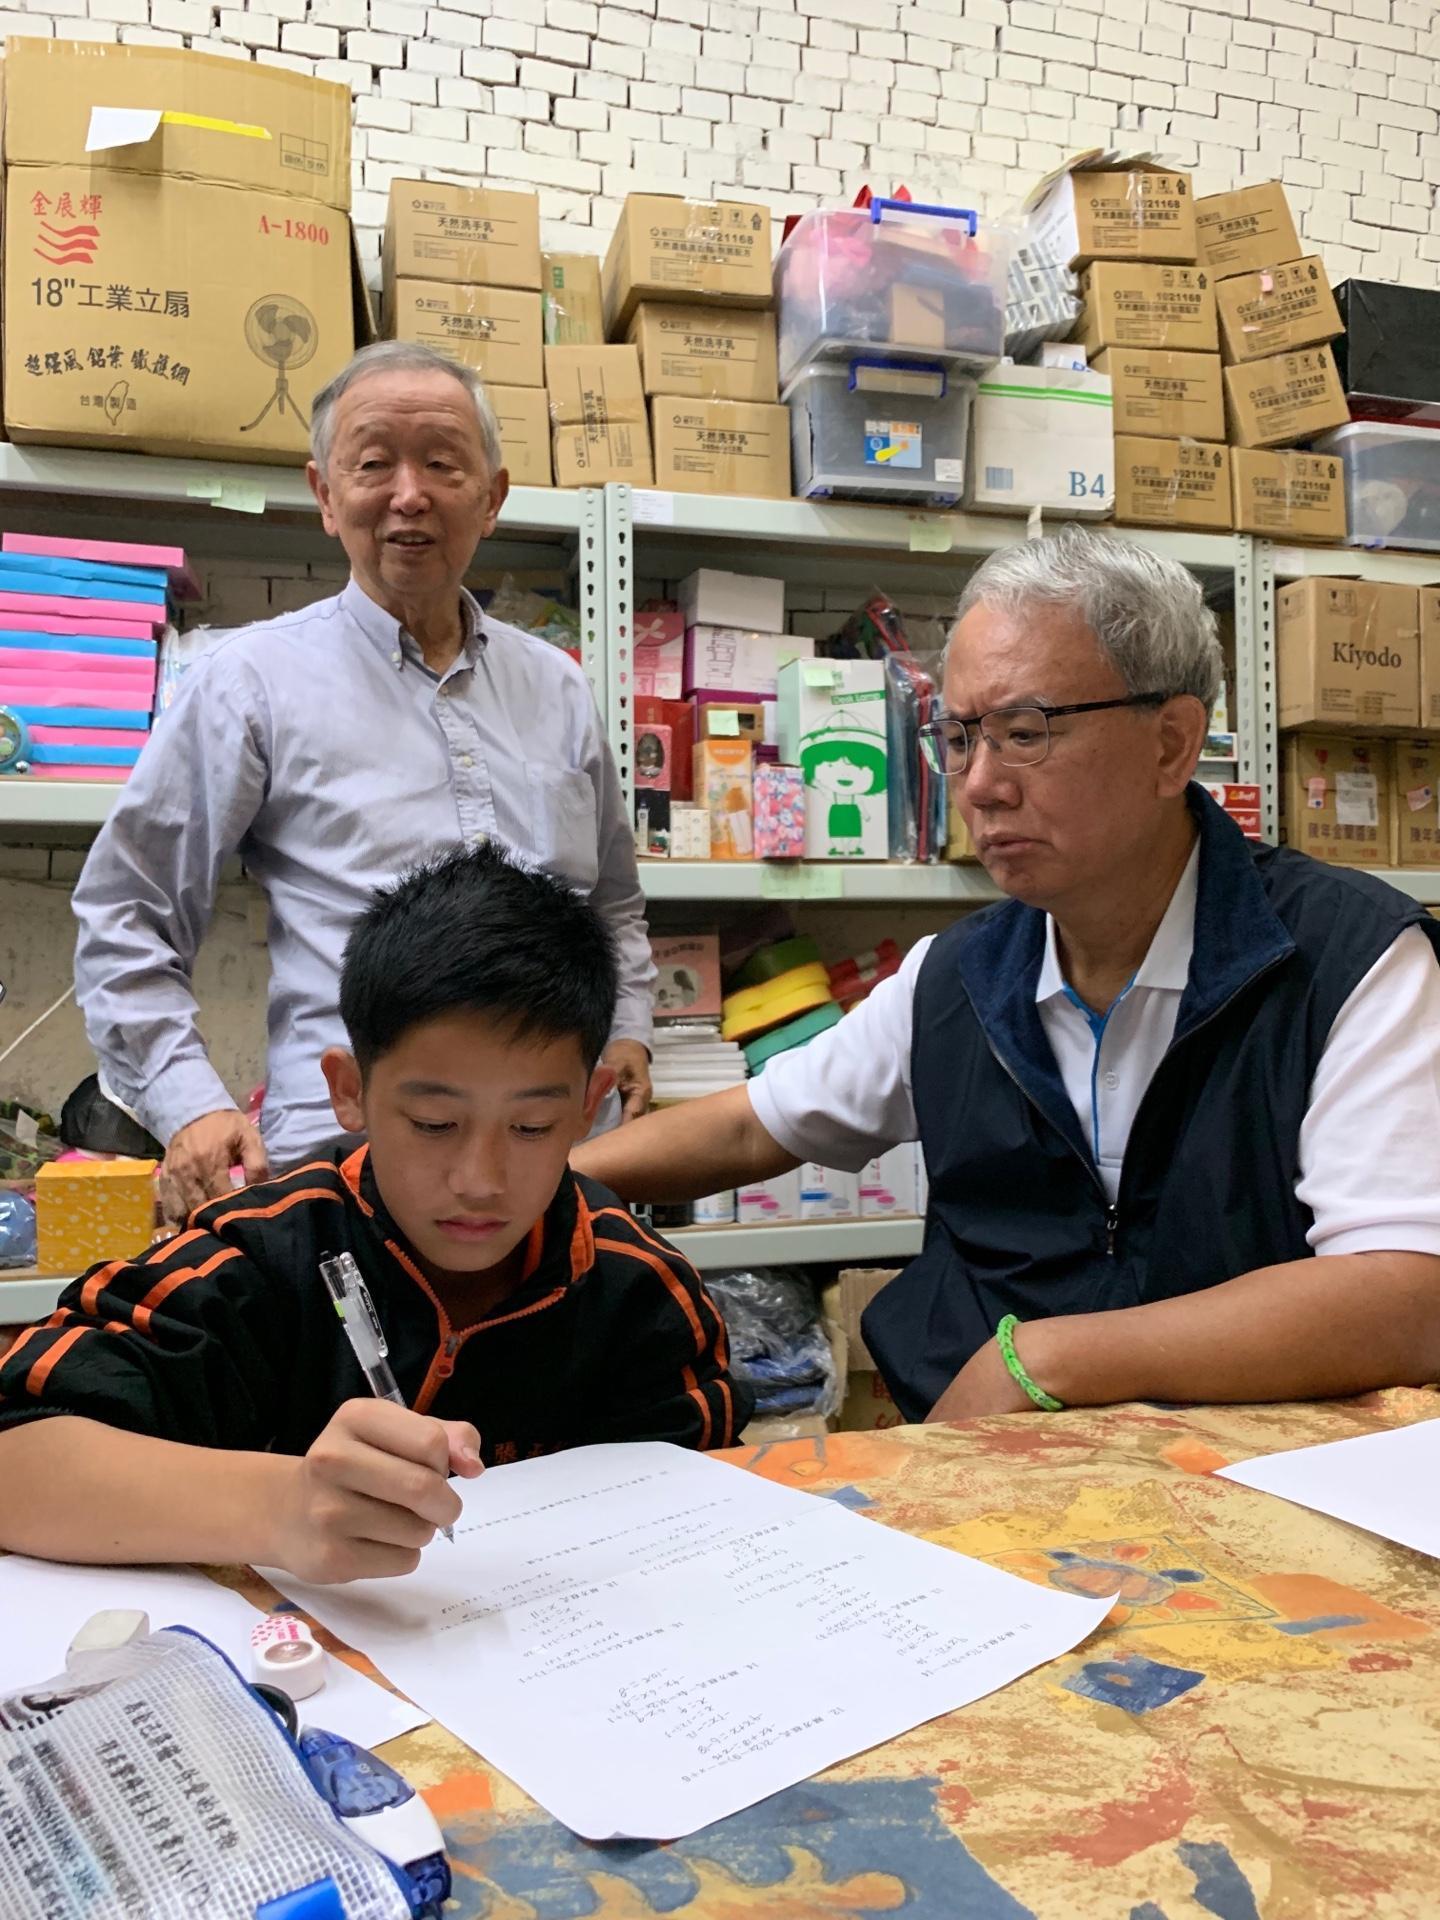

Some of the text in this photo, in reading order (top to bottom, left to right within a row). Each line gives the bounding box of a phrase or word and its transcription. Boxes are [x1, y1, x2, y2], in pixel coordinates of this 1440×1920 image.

[31, 190, 103, 220] 金展輝
[258, 215, 329, 245] A-1800
[437, 216, 495, 233] 天然洗手乳
[86, 345, 124, 369] 鋁葉
[131, 348, 191, 386] 鐵護網
[1068, 471, 1106, 498] B4
[1333, 642, 1401, 670] Kiyodo
